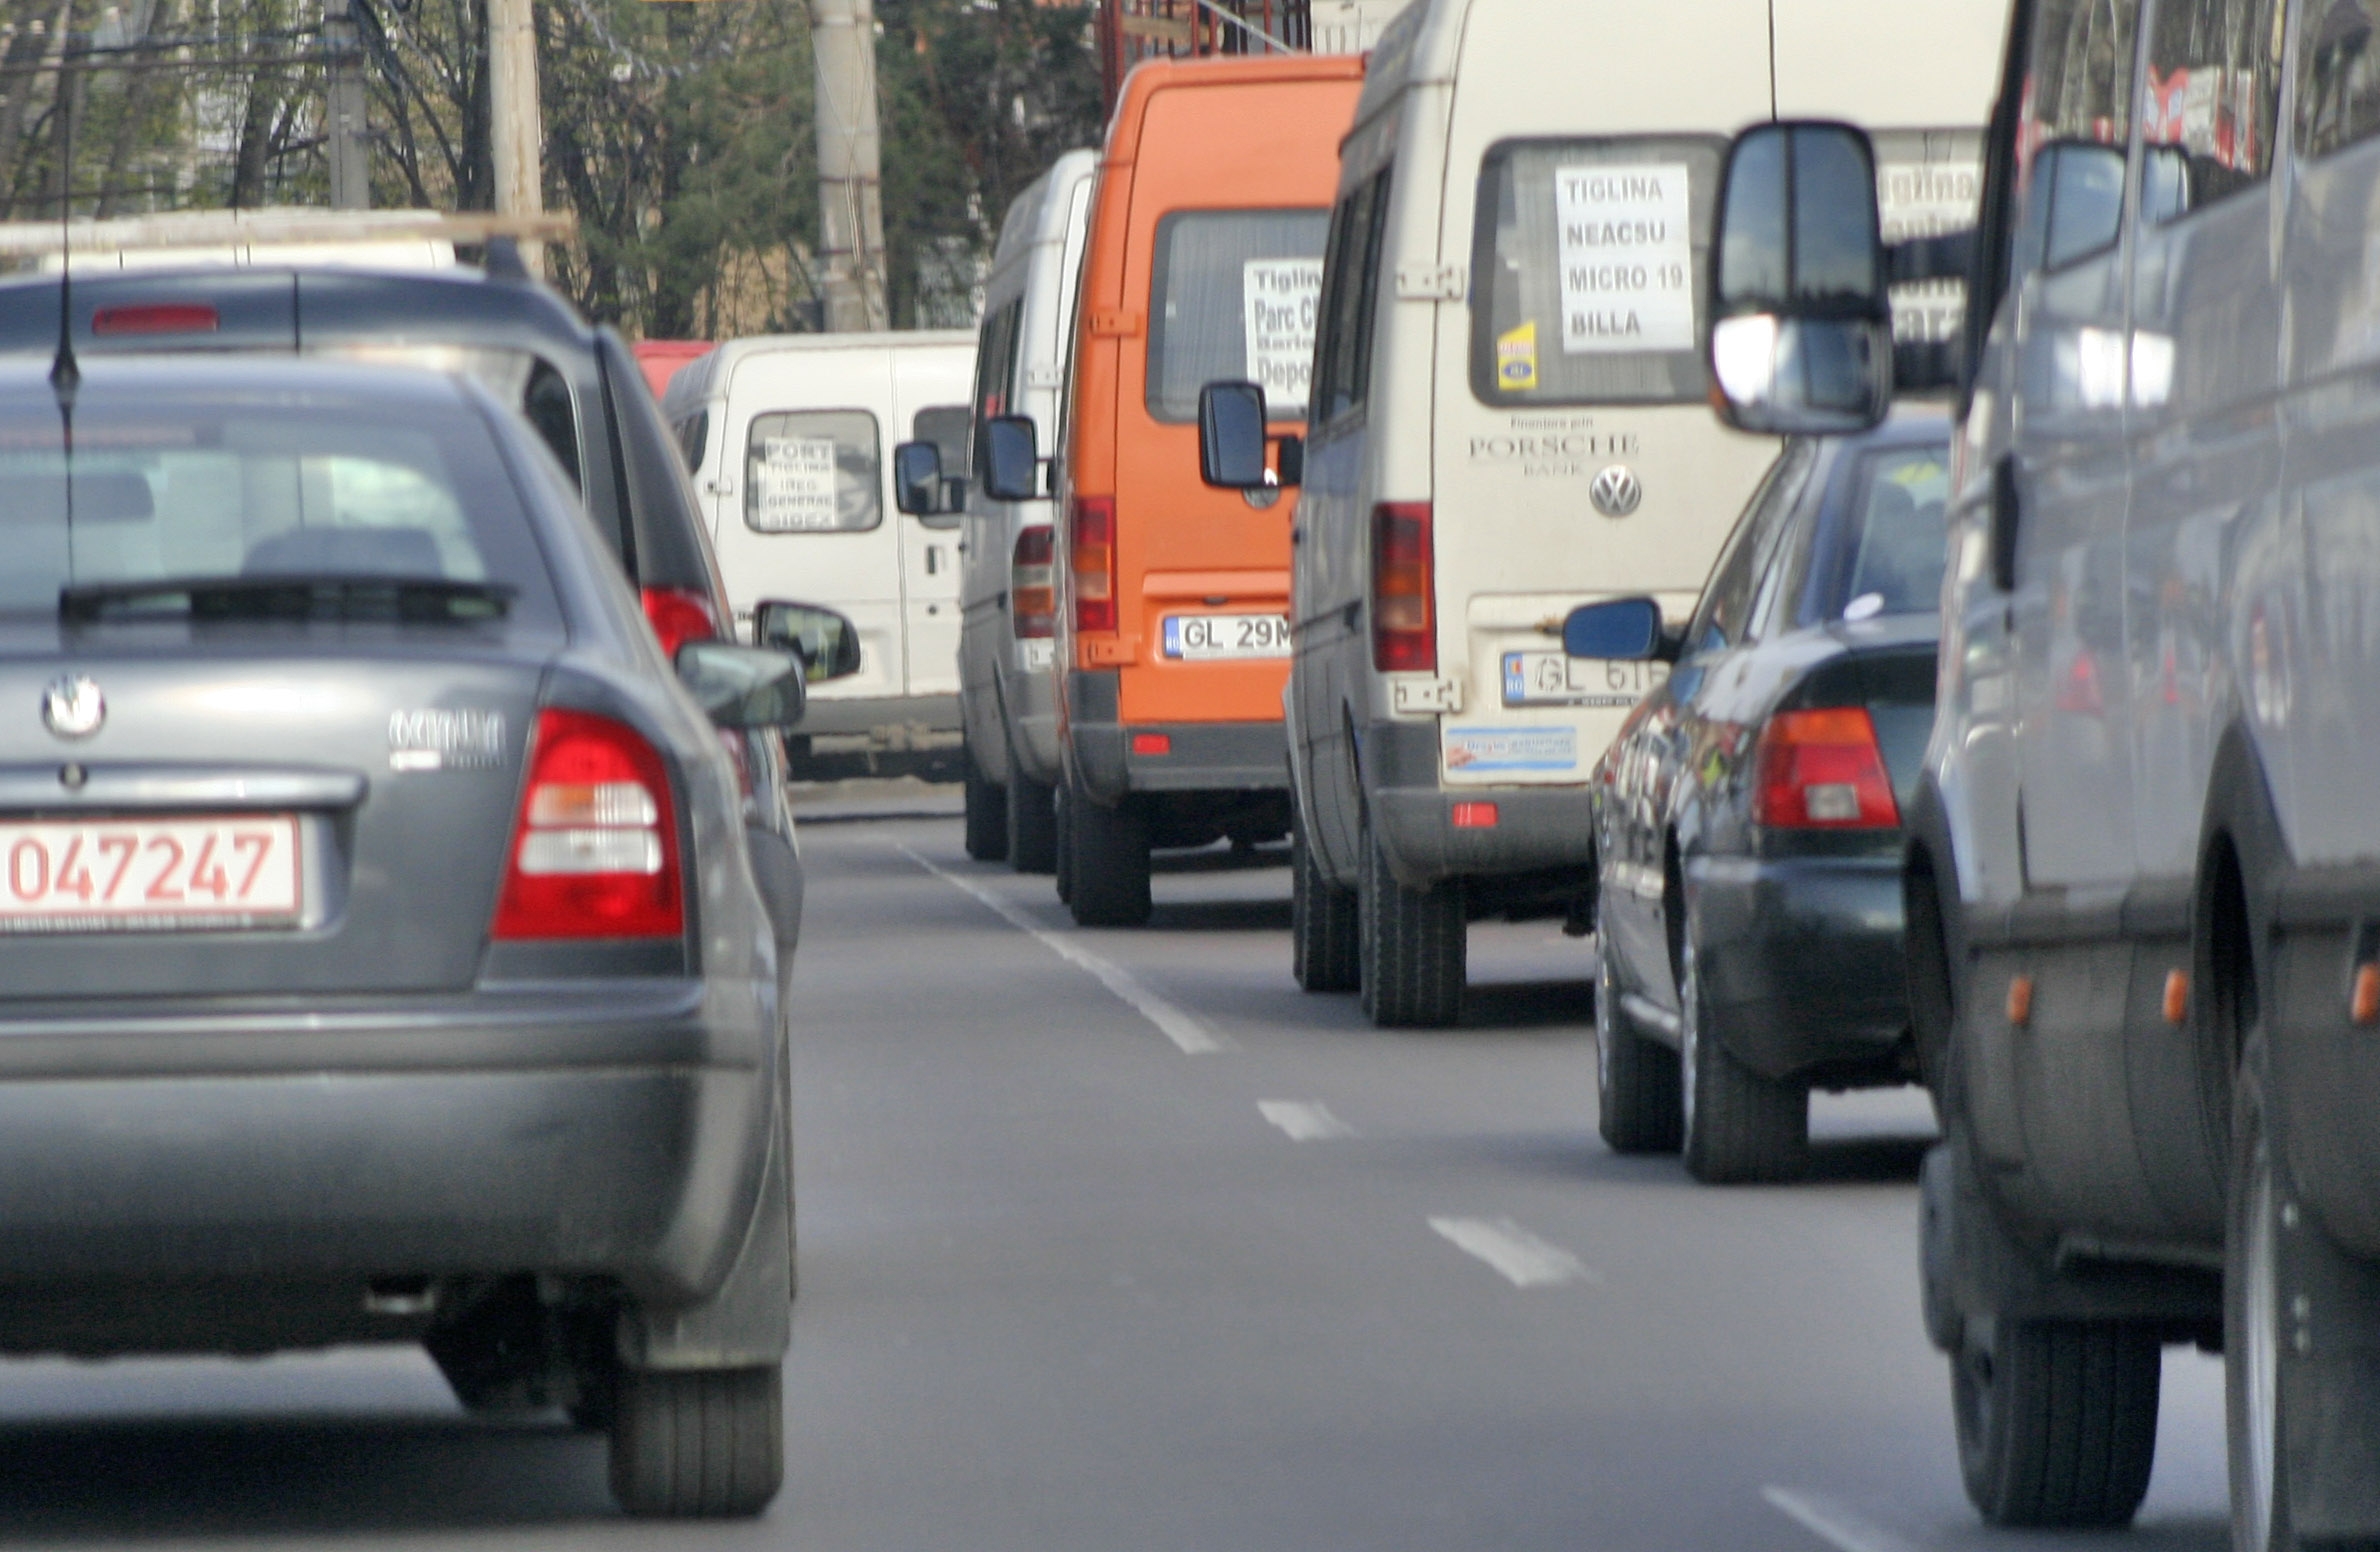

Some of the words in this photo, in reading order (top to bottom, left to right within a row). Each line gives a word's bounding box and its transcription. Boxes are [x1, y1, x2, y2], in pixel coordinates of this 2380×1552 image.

[1564, 177, 1664, 203] TIGLINA
[1567, 221, 1667, 247] NEACSU
[1568, 265, 1647, 292] MICRO
[1657, 263, 1684, 288] 19
[1255, 298, 1296, 333] Parc
[1571, 309, 1642, 337] BILLA
[1469, 433, 1640, 459] PORSCHE
[1184, 620, 1224, 648] GL
[1237, 619, 1292, 648] 29M
[1535, 657, 1586, 692] GL
[9, 832, 275, 902] 047247
